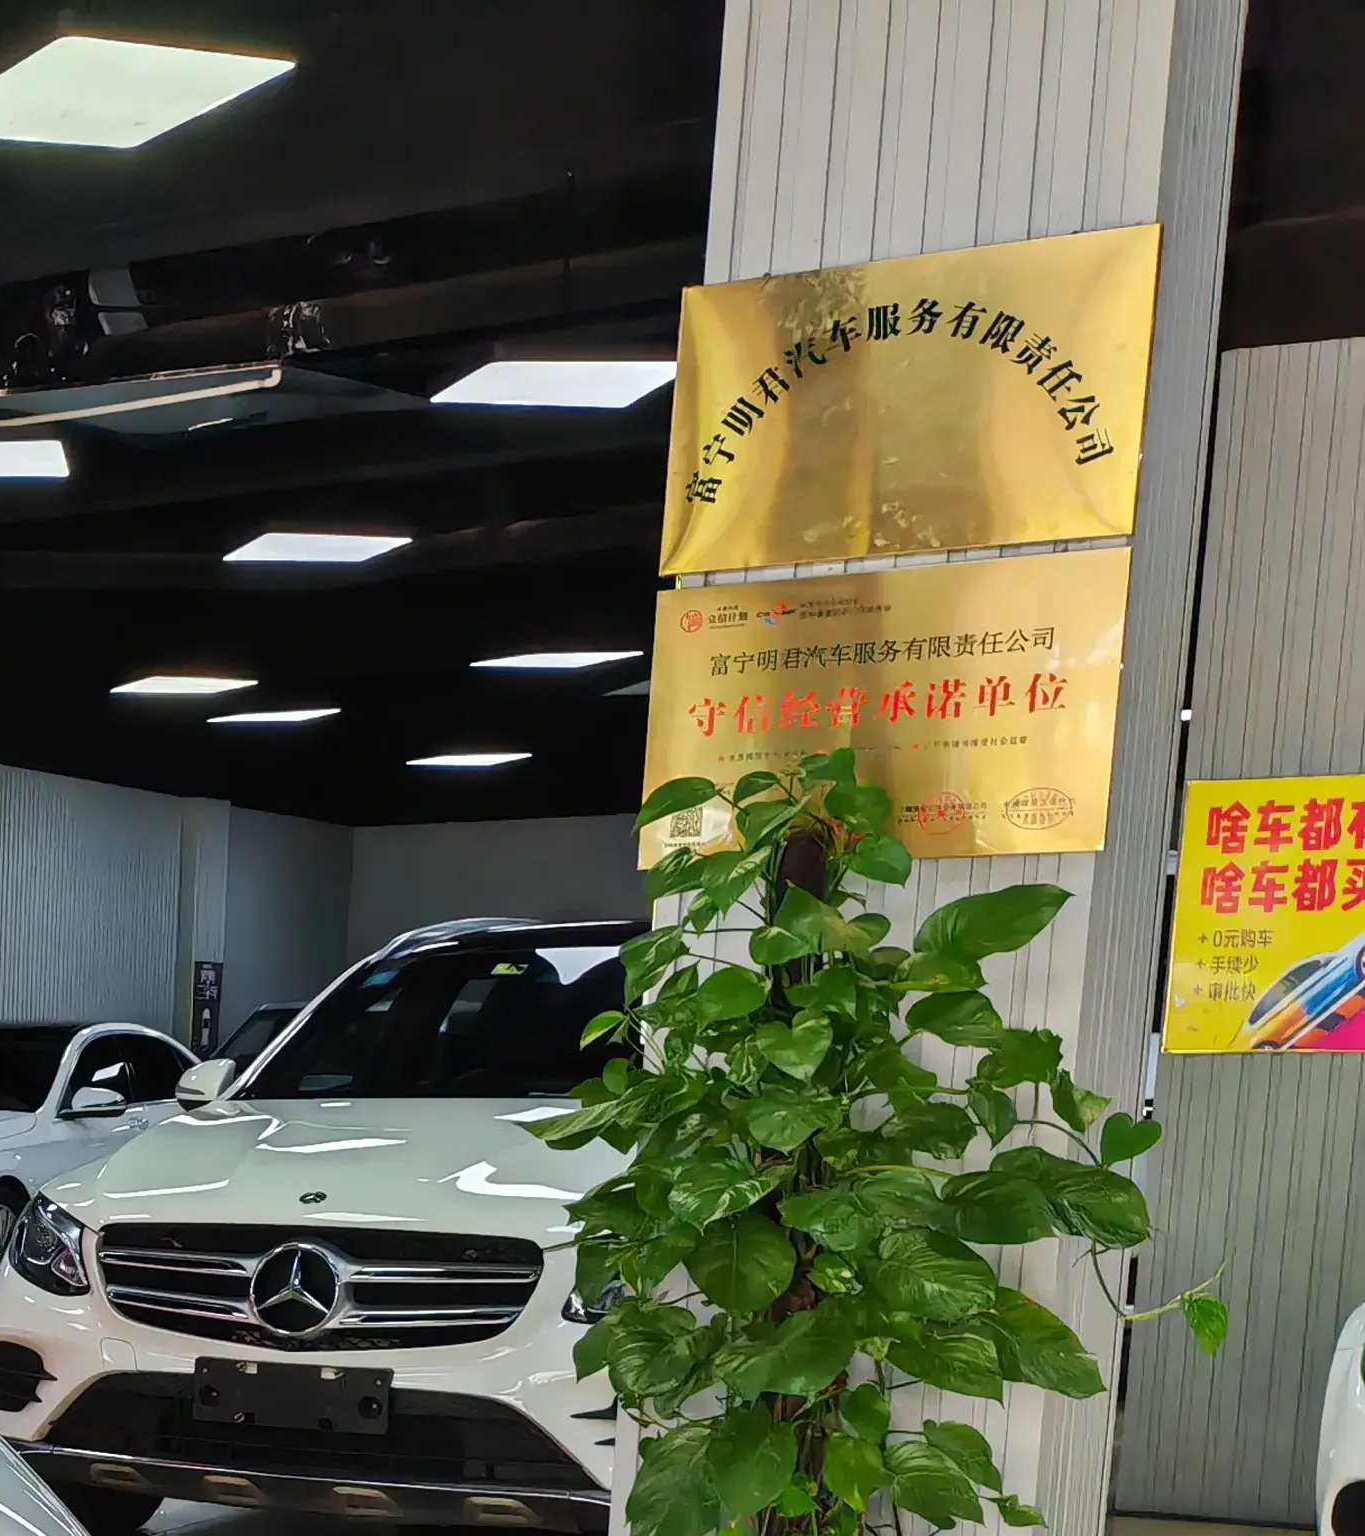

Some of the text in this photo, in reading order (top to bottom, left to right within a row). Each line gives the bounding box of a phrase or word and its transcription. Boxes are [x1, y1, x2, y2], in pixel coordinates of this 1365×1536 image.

[685, 297, 1115, 504] 富宁明君汽车服务有限责任公司
[709, 626, 1055, 677] 富宁明君汽车服务有限责任公司
[687, 672, 1070, 738] 守信经营承诺单位
[1212, 929, 1273, 948] 0元购车
[1209, 956, 1259, 975] 手续少
[1208, 982, 1256, 1001] 审批快
